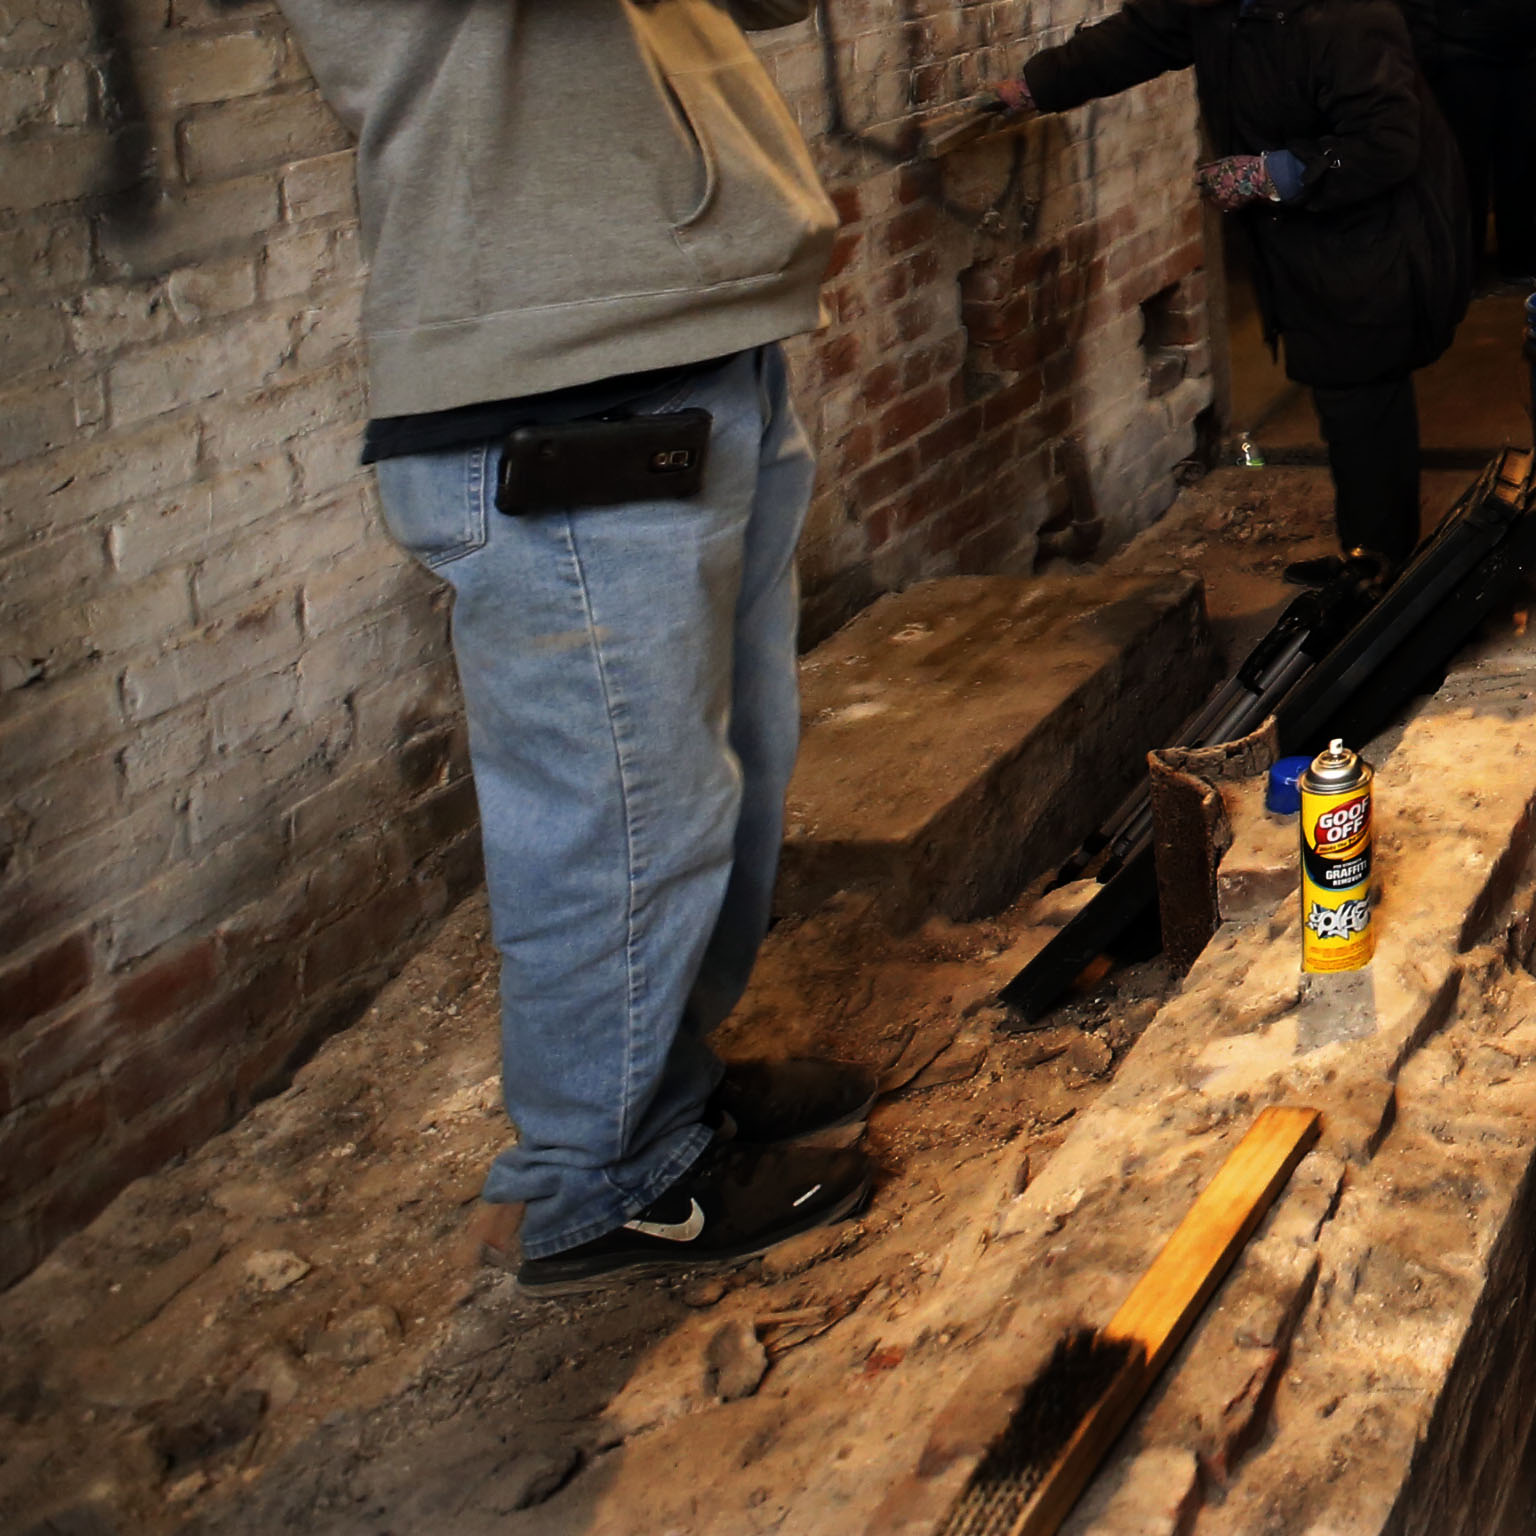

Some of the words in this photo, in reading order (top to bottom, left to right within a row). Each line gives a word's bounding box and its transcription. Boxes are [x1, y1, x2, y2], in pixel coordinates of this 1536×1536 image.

[1319, 795, 1368, 829] GOOF
[1327, 814, 1363, 842] OFF
[1326, 860, 1367, 881] GRAFFITI
